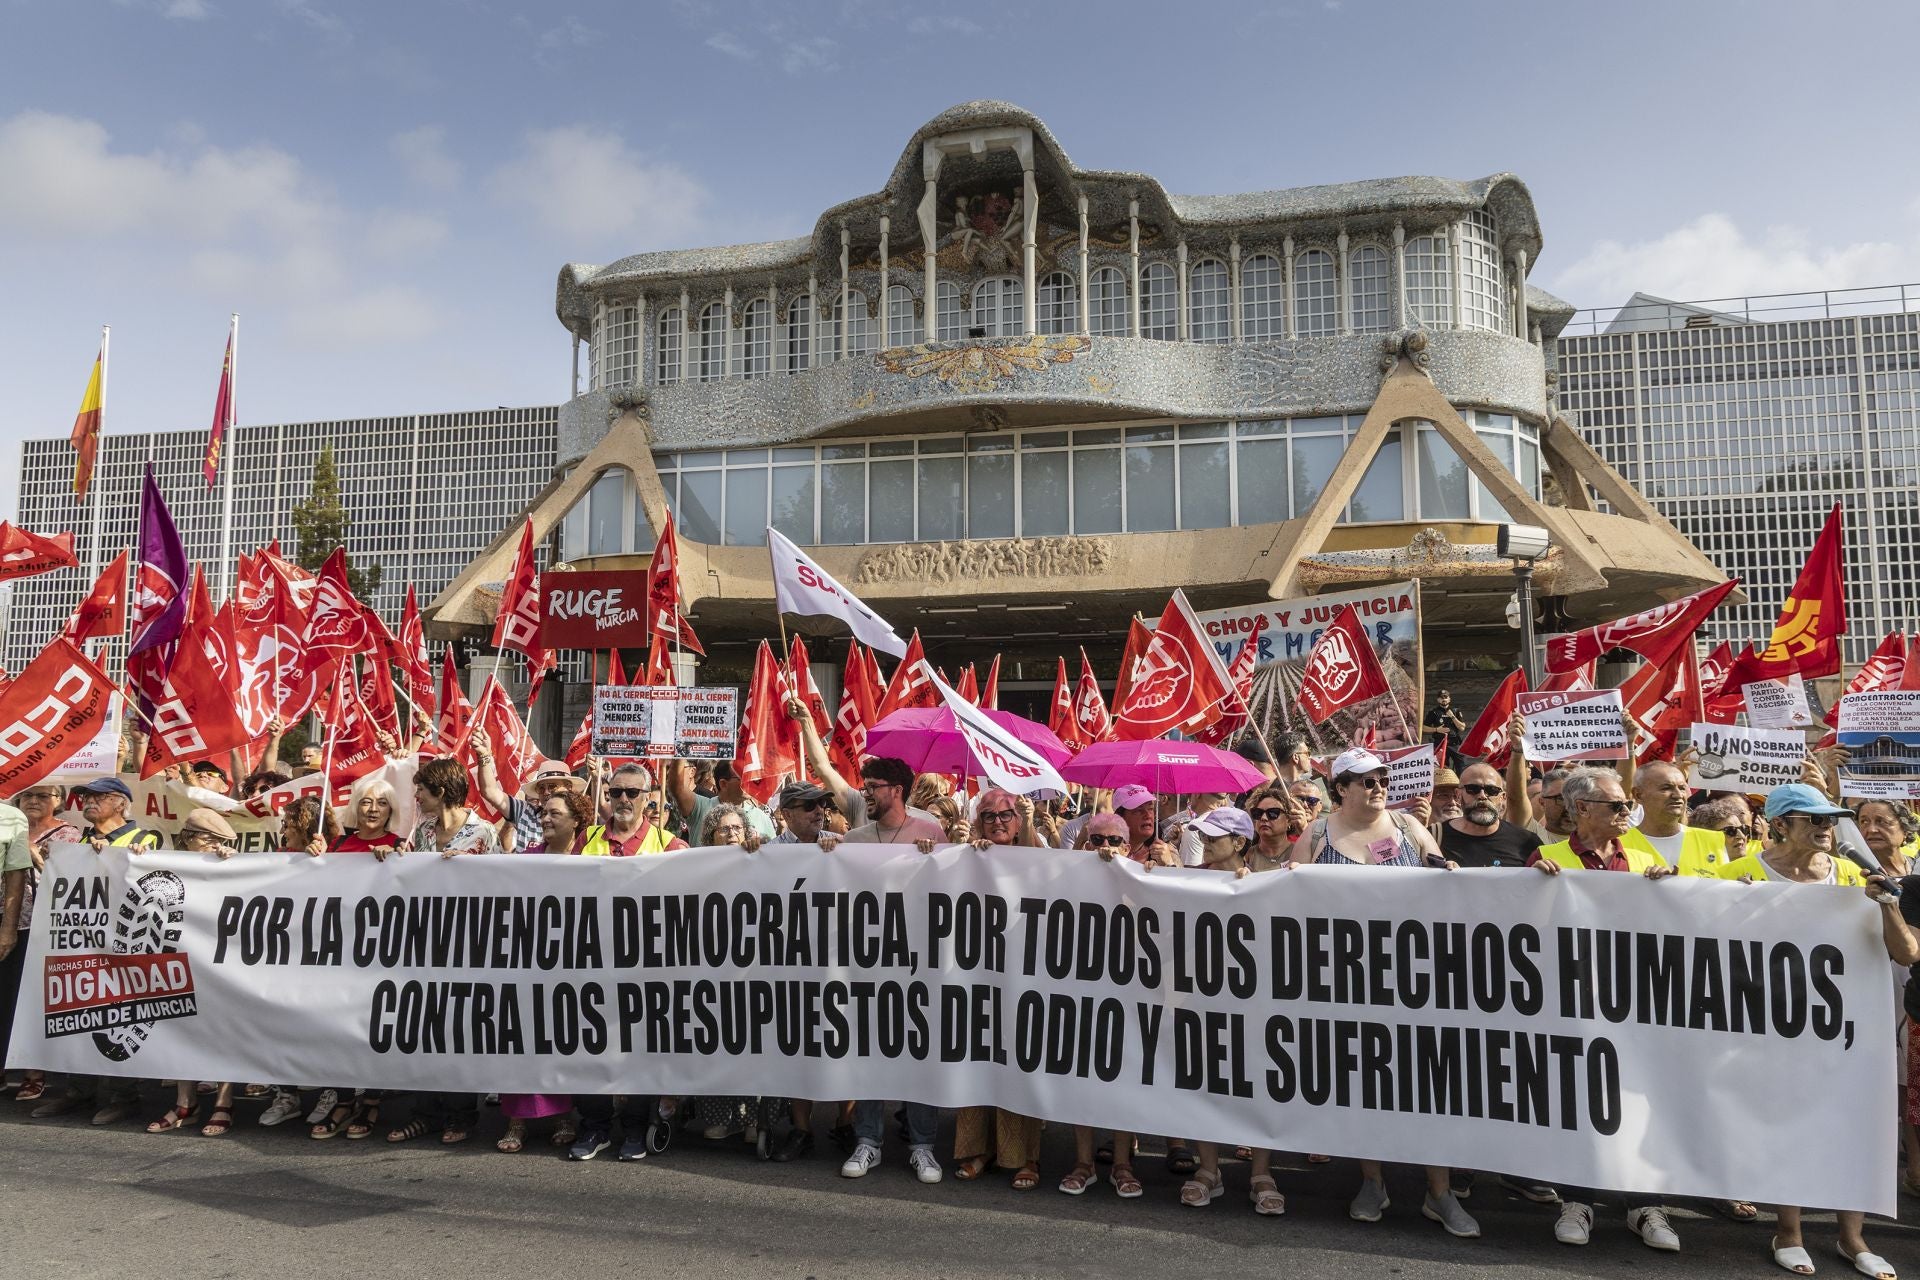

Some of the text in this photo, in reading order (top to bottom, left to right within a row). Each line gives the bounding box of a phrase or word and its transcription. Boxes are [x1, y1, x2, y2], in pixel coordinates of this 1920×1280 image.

[548, 588, 623, 620] RUGE
[595, 608, 639, 631] MURCIA
[1202, 615, 1270, 637] CHOS
[1275, 611, 1291, 627] Y
[600, 690, 650, 699] NO AL CIERRE
[1751, 688, 1785, 696] PARTIDO
[706, 693, 732, 702] CIERRE
[1753, 695, 1785, 703] CONTRA
[602, 703, 644, 712] CENTRO DE
[1522, 698, 1548, 714] UGT
[1564, 705, 1620, 714] DERECHA
[1754, 700, 1794, 709] FASCISMO
[684, 706, 727, 714] CENTRO DE
[604, 713, 642, 722] MENORES
[686, 715, 724, 724] MENORES
[1542, 718, 1622, 727] ULTRADERECHA
[600, 726, 646, 735] SANTA CRUZ
[682, 729, 729, 738] SANTA CRUZ
[1549, 730, 1579, 738] ALÍAN
[1535, 743, 1554, 751] LOS
[1556, 741, 1578, 750] MÁS
[1581, 741, 1623, 749] DÉBILES
[1729, 738, 1803, 756] NO SOBRAN
[1158, 754, 1200, 764] Sumar
[1753, 750, 1804, 759] INMIGRANTES
[1388, 758, 1430, 770] ERECHA
[1700, 760, 1722, 771] STOP
[1740, 762, 1802, 775] SOBRAN
[1398, 781, 1431, 791] CONTRA
[146, 792, 178, 820] AL
[50, 876, 110, 910] PAN
[50, 912, 109, 927] TRABAJO
[50, 929, 106, 950] TECHO
[48, 958, 110, 973] MARCHAS DE LA
[212, 878, 1855, 1051] POR LA CONVIVENCIA DEMOCRÁTICA, POR TODOS LOS DERECHOS HUMANOS,
[48, 960, 188, 1006] DIGNIDAD
[47, 998, 197, 1034] REGIÓN DE MURCIA
[369, 979, 1622, 1136] CONTRA LOS PRESUPUESTOS DEL ODIO Y DEL SUFRIMIENTO
